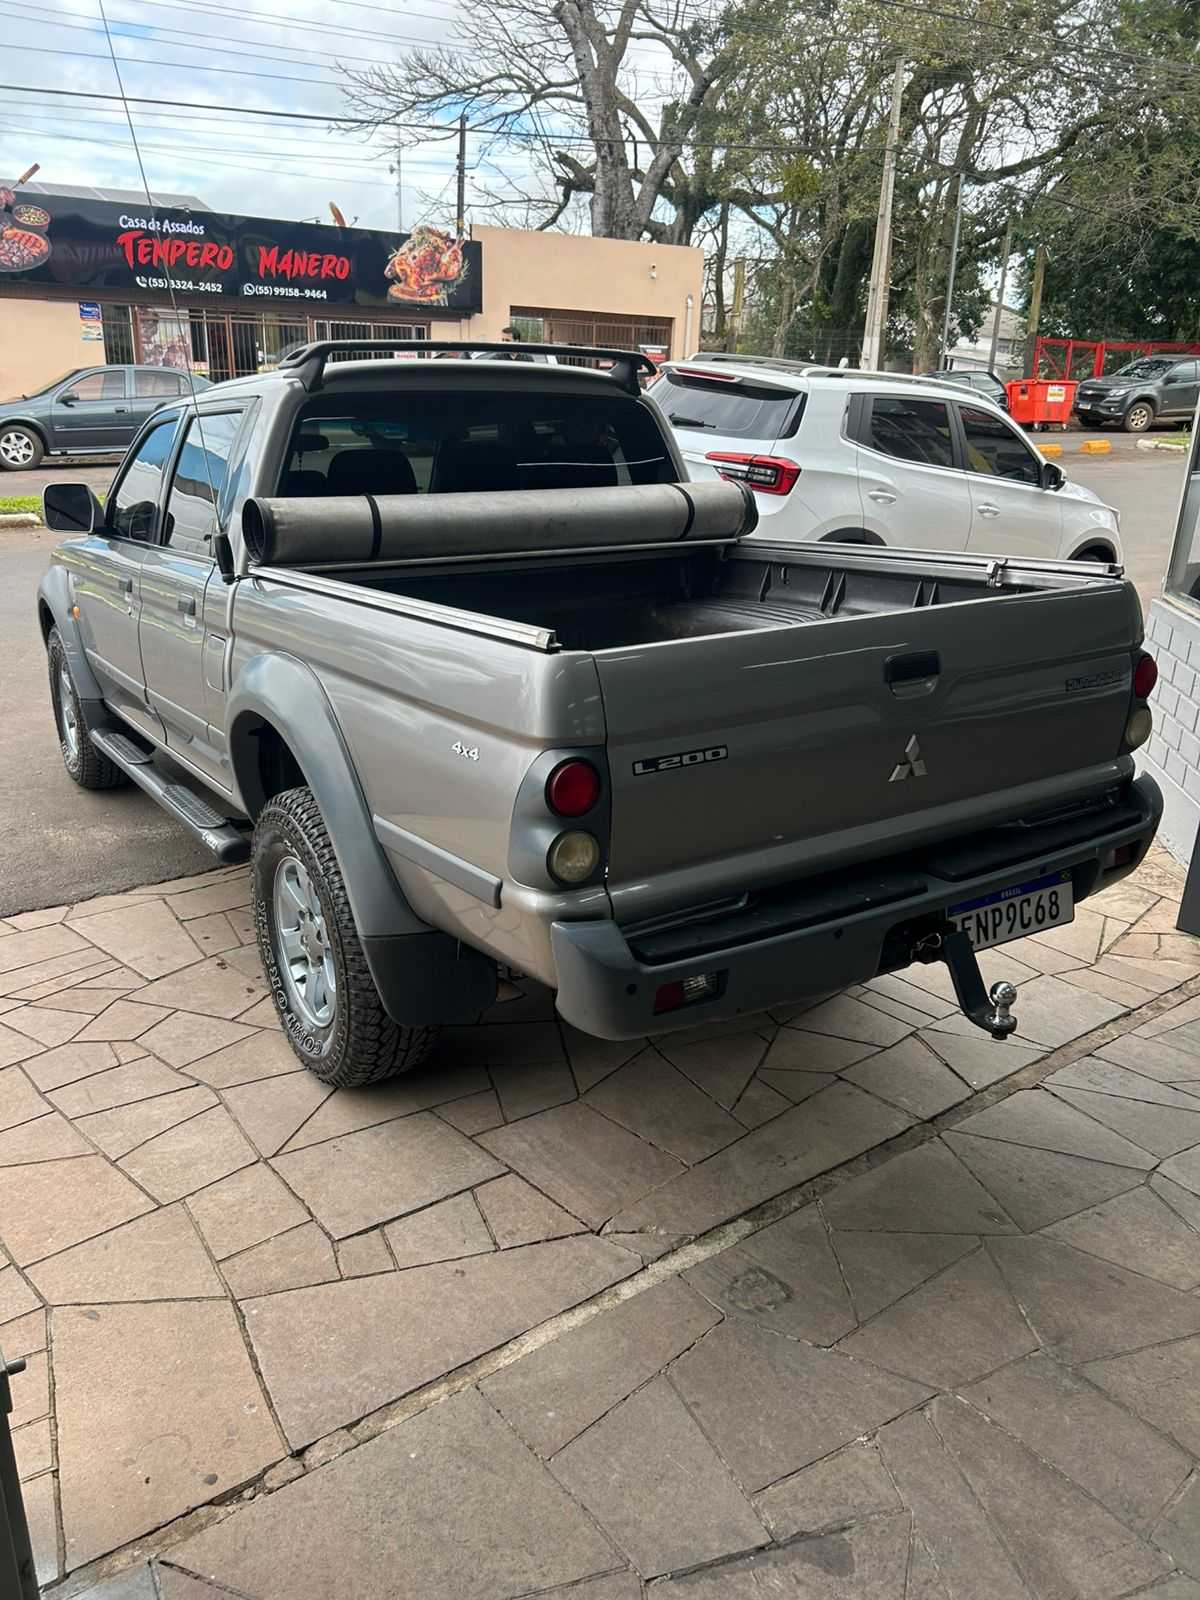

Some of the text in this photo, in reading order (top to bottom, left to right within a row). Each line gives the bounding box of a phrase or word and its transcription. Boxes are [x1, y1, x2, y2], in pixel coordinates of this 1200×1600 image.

[119, 215, 205, 235] Casa de Assados
[116, 230, 350, 281] TEMPERO MANERO
[148, 277, 223, 293] (55) 3324-2452
[255, 285, 328, 300] (55) 99158-9464
[451, 741, 480, 761] 4x4
[633, 746, 728, 775] L200
[961, 890, 1060, 944] ENP9C68
